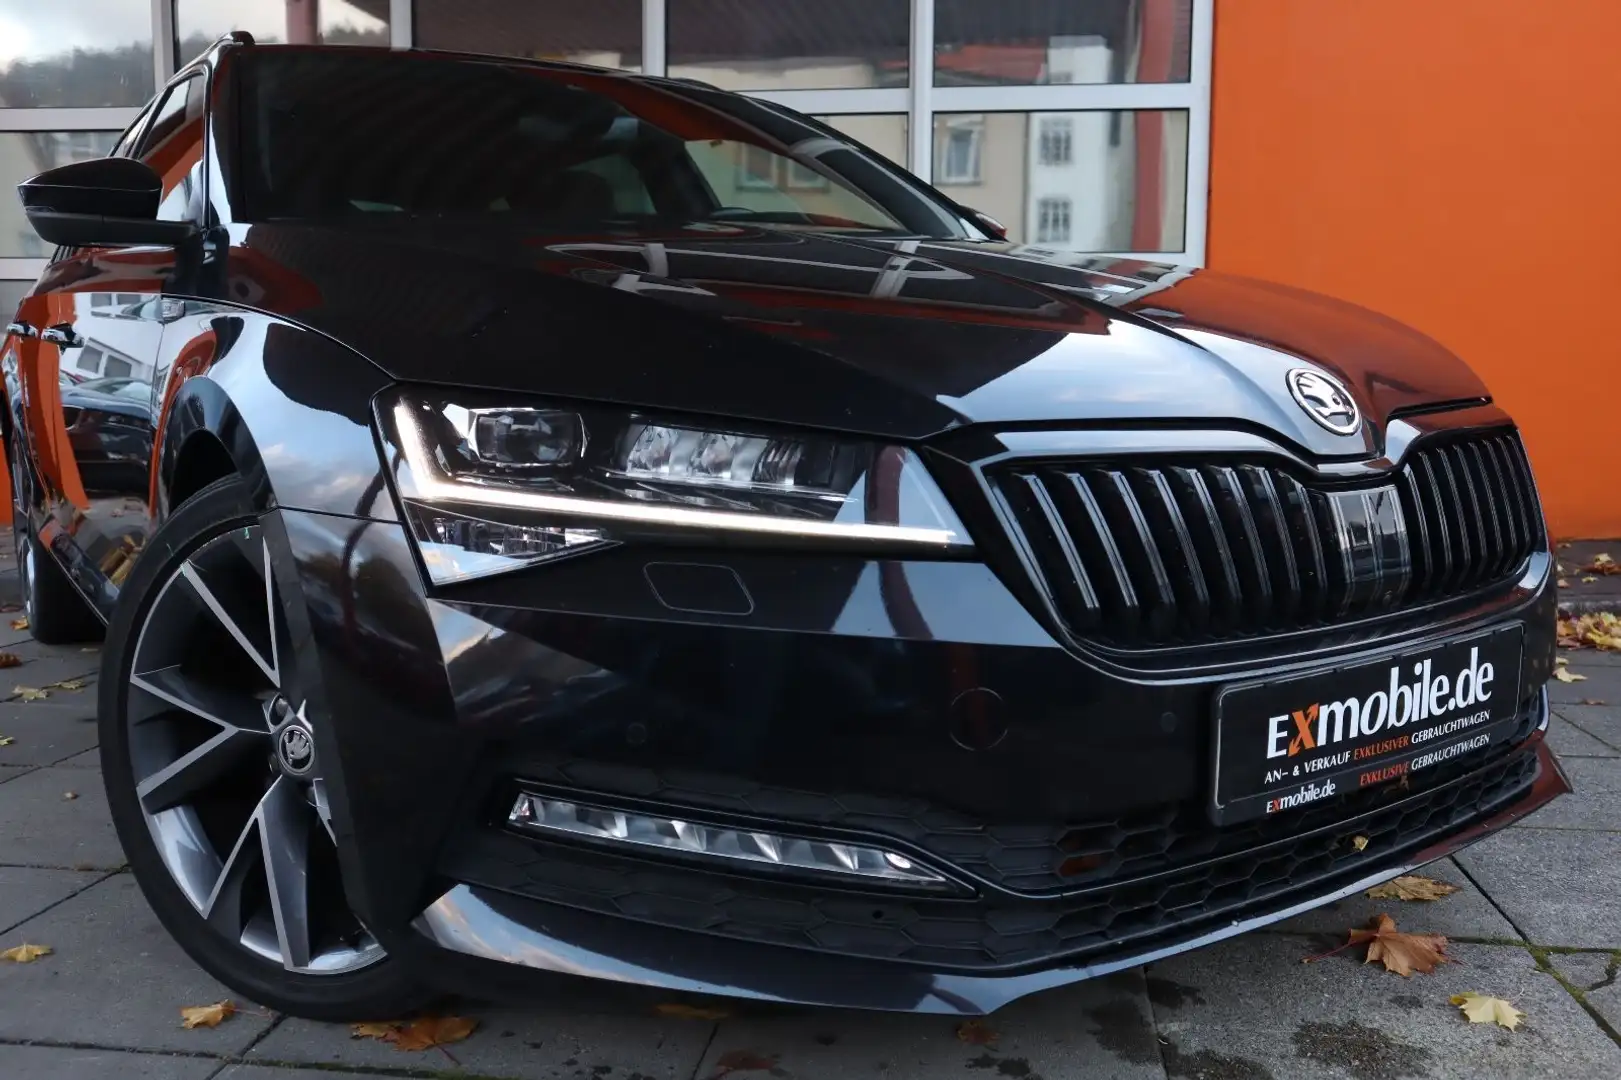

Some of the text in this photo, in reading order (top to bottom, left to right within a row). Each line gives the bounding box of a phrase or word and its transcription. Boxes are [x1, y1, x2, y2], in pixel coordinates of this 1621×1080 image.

[1292, 765, 1300, 777] &
[1304, 750, 1352, 773] VERKAUF
[1353, 735, 1409, 760] EXKLUSIVER
[1411, 710, 1491, 744] GEBRAUCHTWAGEN
[1411, 733, 1491, 771] GEBRAUCHTWAGEN
